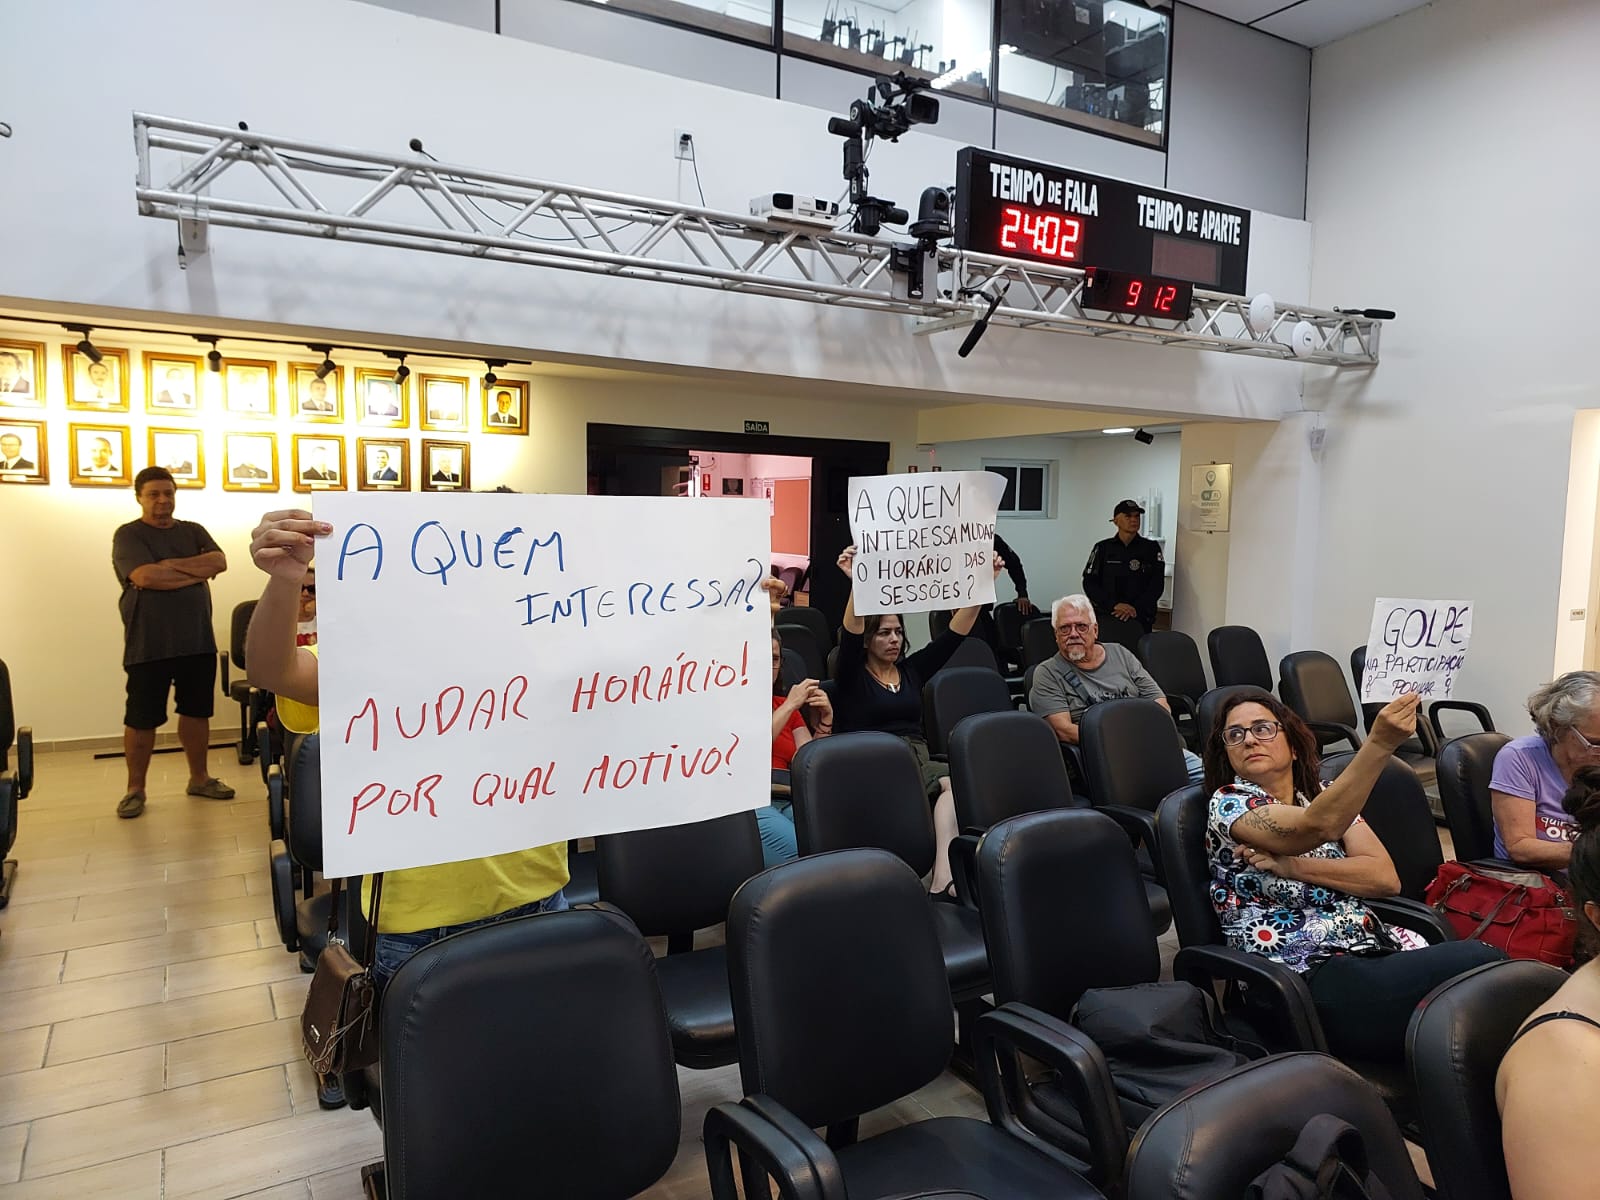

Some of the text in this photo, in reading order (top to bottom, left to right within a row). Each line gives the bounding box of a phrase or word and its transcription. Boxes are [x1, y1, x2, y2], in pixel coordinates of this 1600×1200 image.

[990, 163, 1098, 217] TEMPO DE FALA
[1138, 195, 1241, 245] TEMPO DE APARTE
[1127, 282, 1176, 311] 9 12
[745, 422, 768, 432] SAÍDA
[855, 482, 961, 525] A QUEM
[338, 520, 565, 585] A QUEM
[861, 525, 958, 554] INTERESSA
[857, 551, 986, 582] O HORÁRIO DAS
[515, 558, 763, 627] INTERESSA?
[1384, 606, 1469, 654] GOLPE
[345, 675, 529, 751] MUDAR
[348, 732, 739, 835] POR QUAL MOTIVO?
